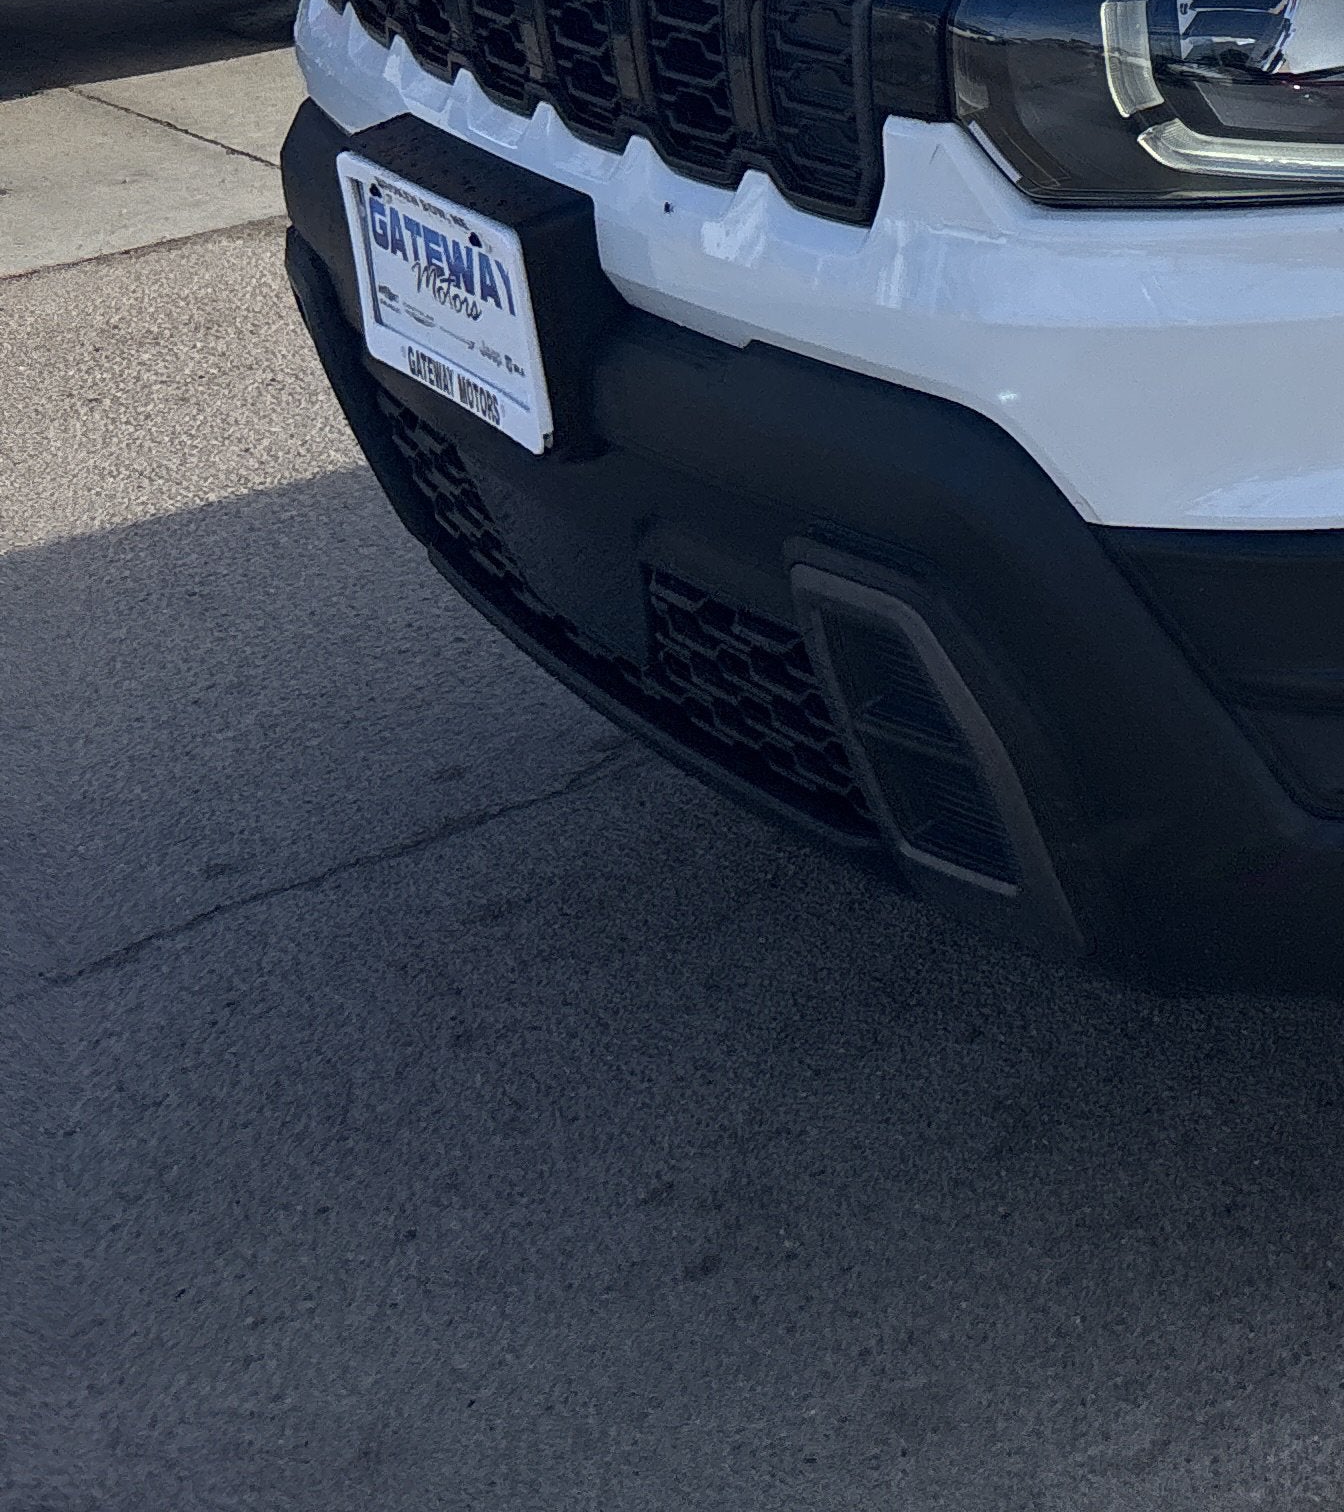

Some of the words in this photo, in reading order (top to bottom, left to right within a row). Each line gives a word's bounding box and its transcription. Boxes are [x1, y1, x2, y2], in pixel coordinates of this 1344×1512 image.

[369, 196, 516, 316] GATEWAY
[412, 261, 482, 321] Motors
[407, 345, 455, 398] GATEWAY
[457, 374, 501, 426] MOTORS
